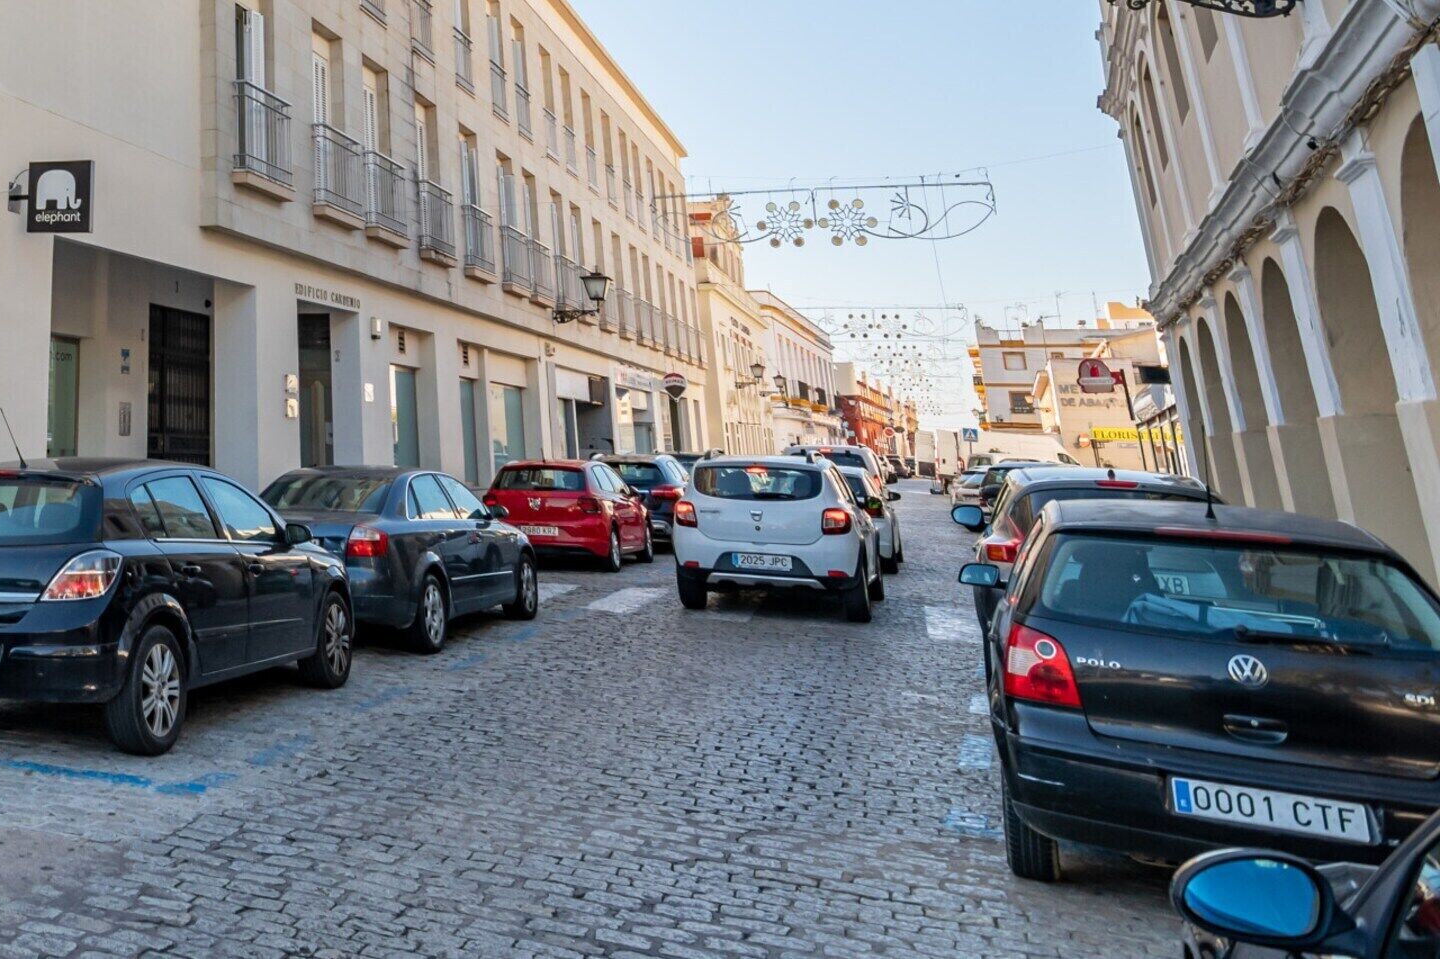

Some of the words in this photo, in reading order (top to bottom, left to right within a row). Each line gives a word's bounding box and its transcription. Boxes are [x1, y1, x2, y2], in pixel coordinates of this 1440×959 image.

[35, 211, 81, 225] elephant
[295, 283, 328, 301] EDIFICIO
[740, 554, 766, 565] 2025
[769, 556, 788, 567] JPC
[1076, 656, 1121, 670] POLO
[1193, 785, 1275, 823] 0001
[1291, 800, 1356, 834] CTF
